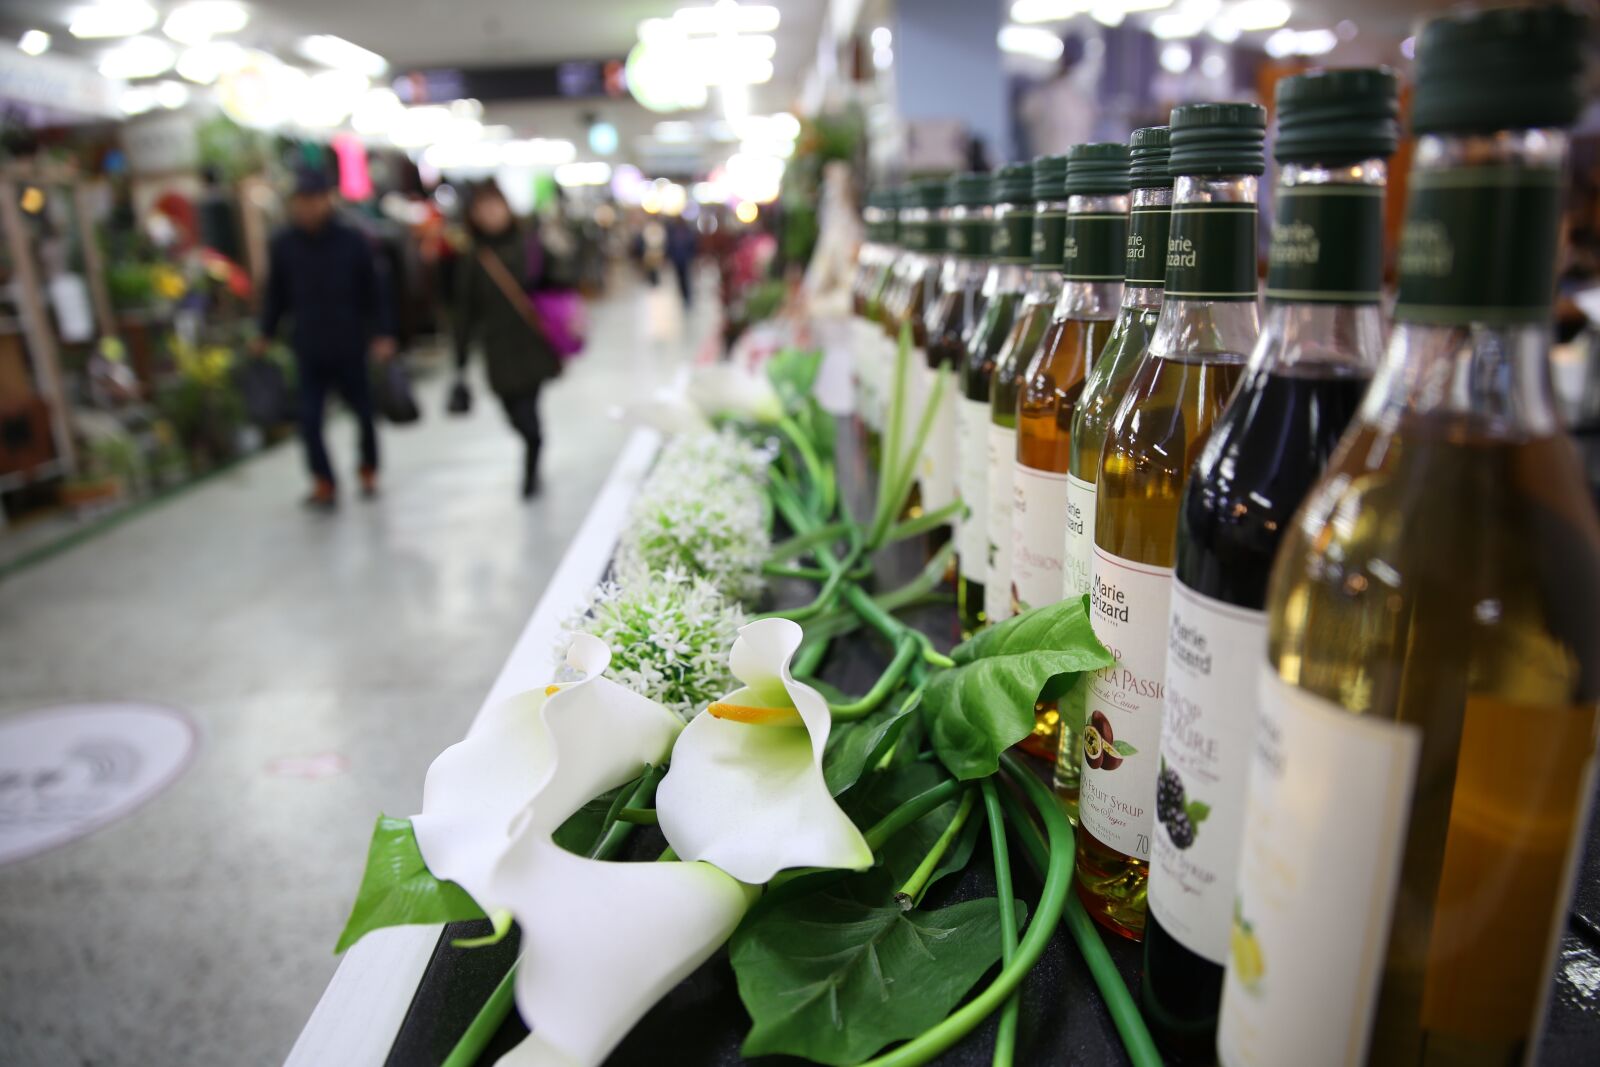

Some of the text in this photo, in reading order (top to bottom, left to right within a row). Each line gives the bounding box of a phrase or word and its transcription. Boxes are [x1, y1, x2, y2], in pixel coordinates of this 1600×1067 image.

[1094, 572, 1125, 605] Marie
[1091, 584, 1129, 624] Brizard
[1110, 794, 1144, 818] SYRUP
[1135, 832, 1150, 855] 70
